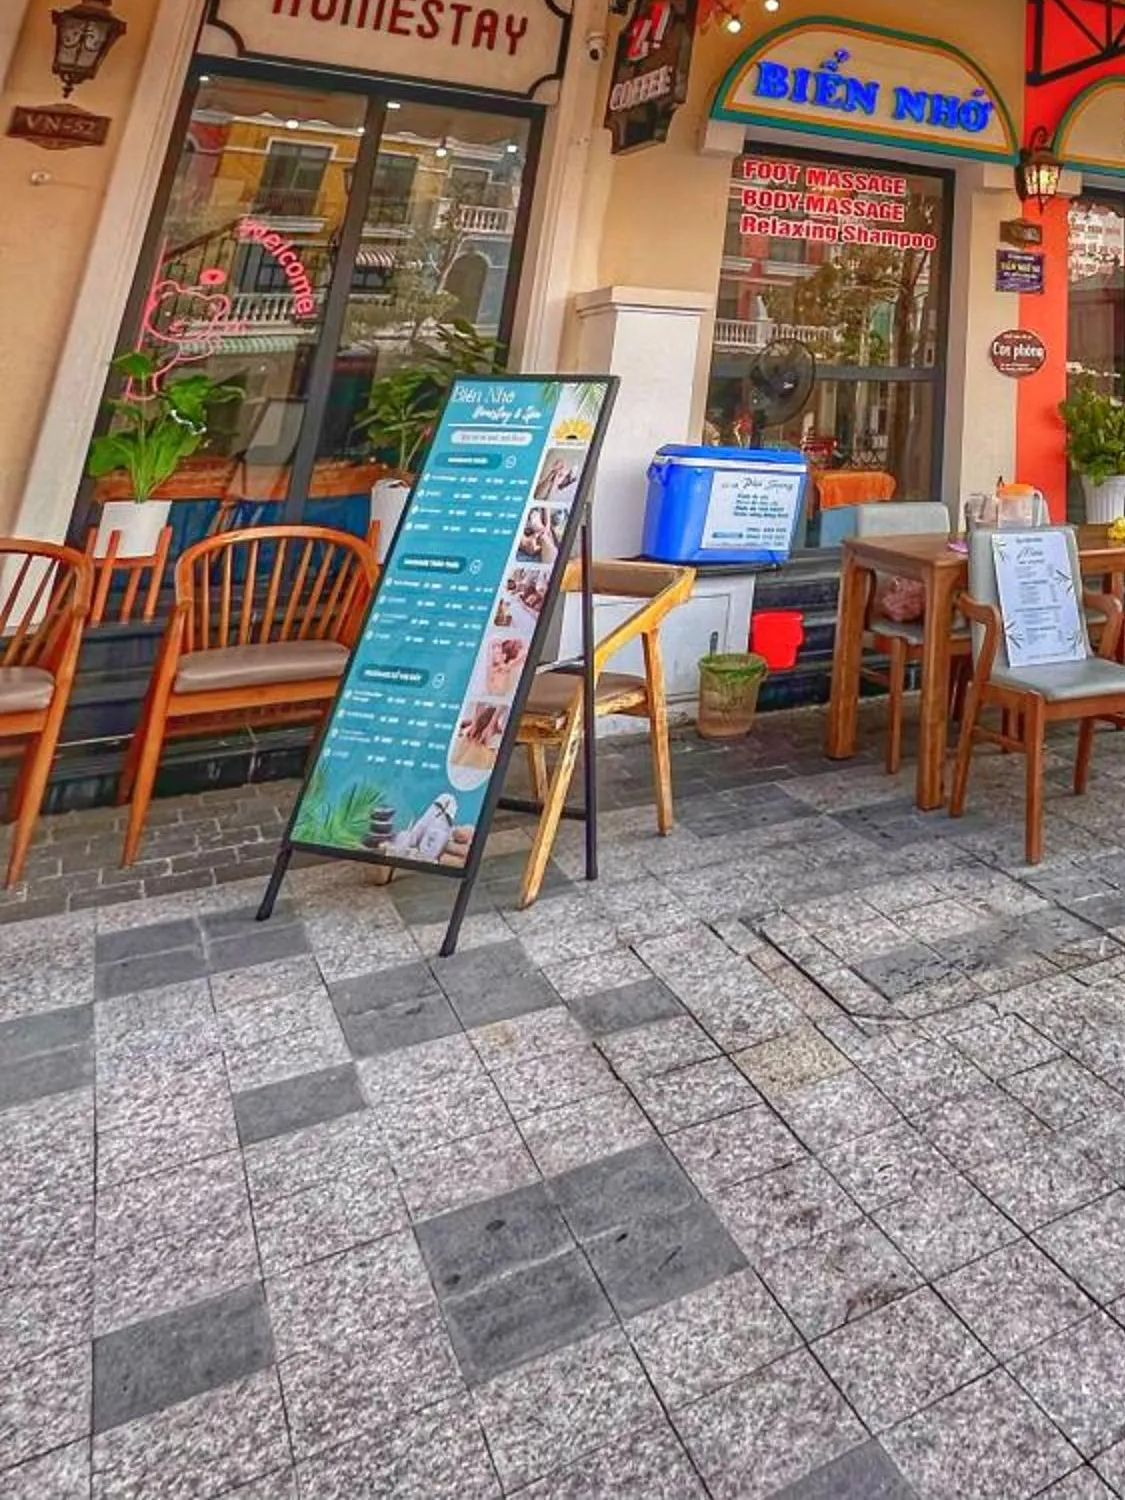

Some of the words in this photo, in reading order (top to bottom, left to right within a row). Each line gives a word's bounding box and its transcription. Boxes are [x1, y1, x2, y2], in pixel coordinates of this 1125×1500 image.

[755, 49, 879, 115] BIỂN
[892, 88, 994, 132] NHỚ
[743, 160, 800, 186] FOOT
[805, 167, 906, 195] MASSAGE
[742, 189, 799, 209] BODY
[805, 192, 905, 222] MASSAGE
[740, 215, 838, 243] Relaxing
[842, 224, 937, 250] Shampoo
